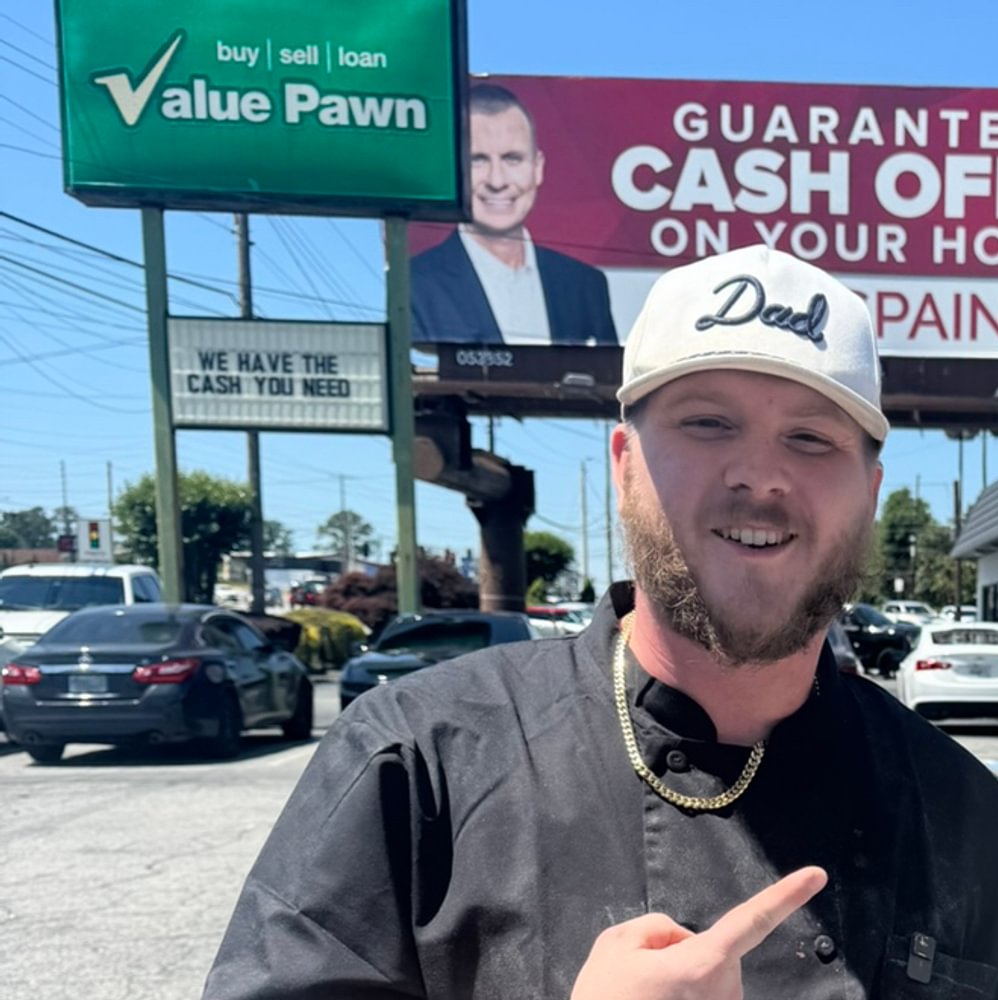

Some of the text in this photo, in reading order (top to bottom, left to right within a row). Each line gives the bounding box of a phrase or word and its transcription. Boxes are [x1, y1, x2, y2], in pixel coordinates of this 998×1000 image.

[217, 40, 387, 68] buy sell loan
[285, 83, 427, 129] Pawn
[611, 145, 850, 215] CASH
[651, 218, 729, 257] ON
[754, 221, 907, 263] YOUR
[695, 273, 827, 343] Dad
[198, 351, 339, 375] WE HAVE THE
[187, 374, 351, 398] CASH YOU NEED
